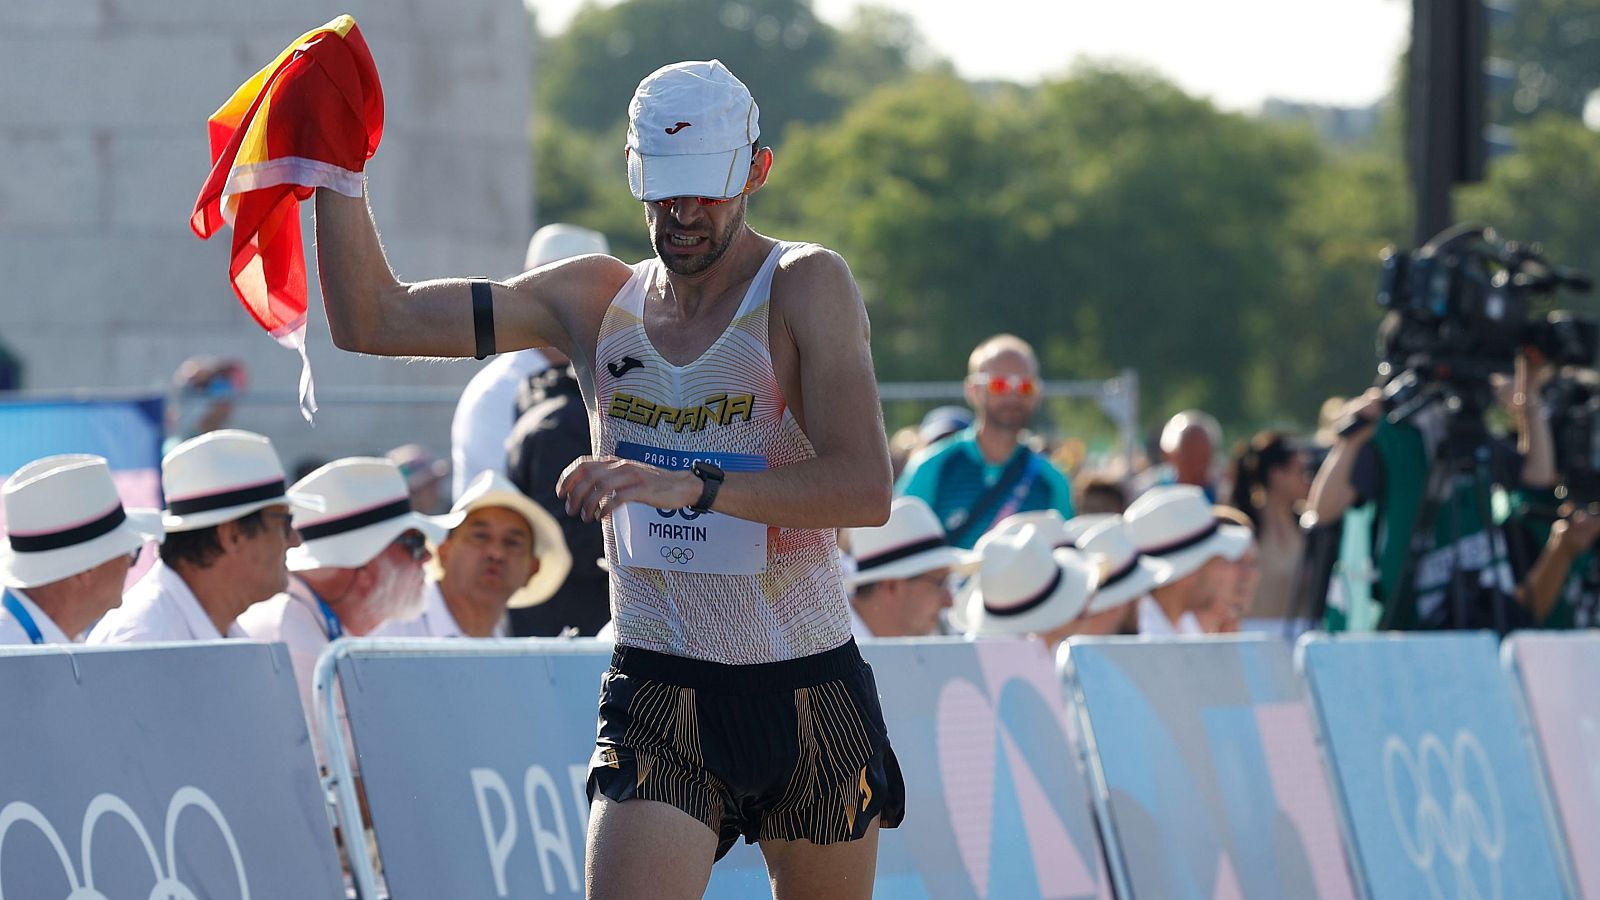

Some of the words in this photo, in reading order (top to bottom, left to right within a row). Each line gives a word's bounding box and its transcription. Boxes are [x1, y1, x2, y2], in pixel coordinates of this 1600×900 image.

[608, 392, 755, 433] ESPAÑA
[644, 452, 677, 467] PARIS
[649, 522, 707, 542] MARTIN
